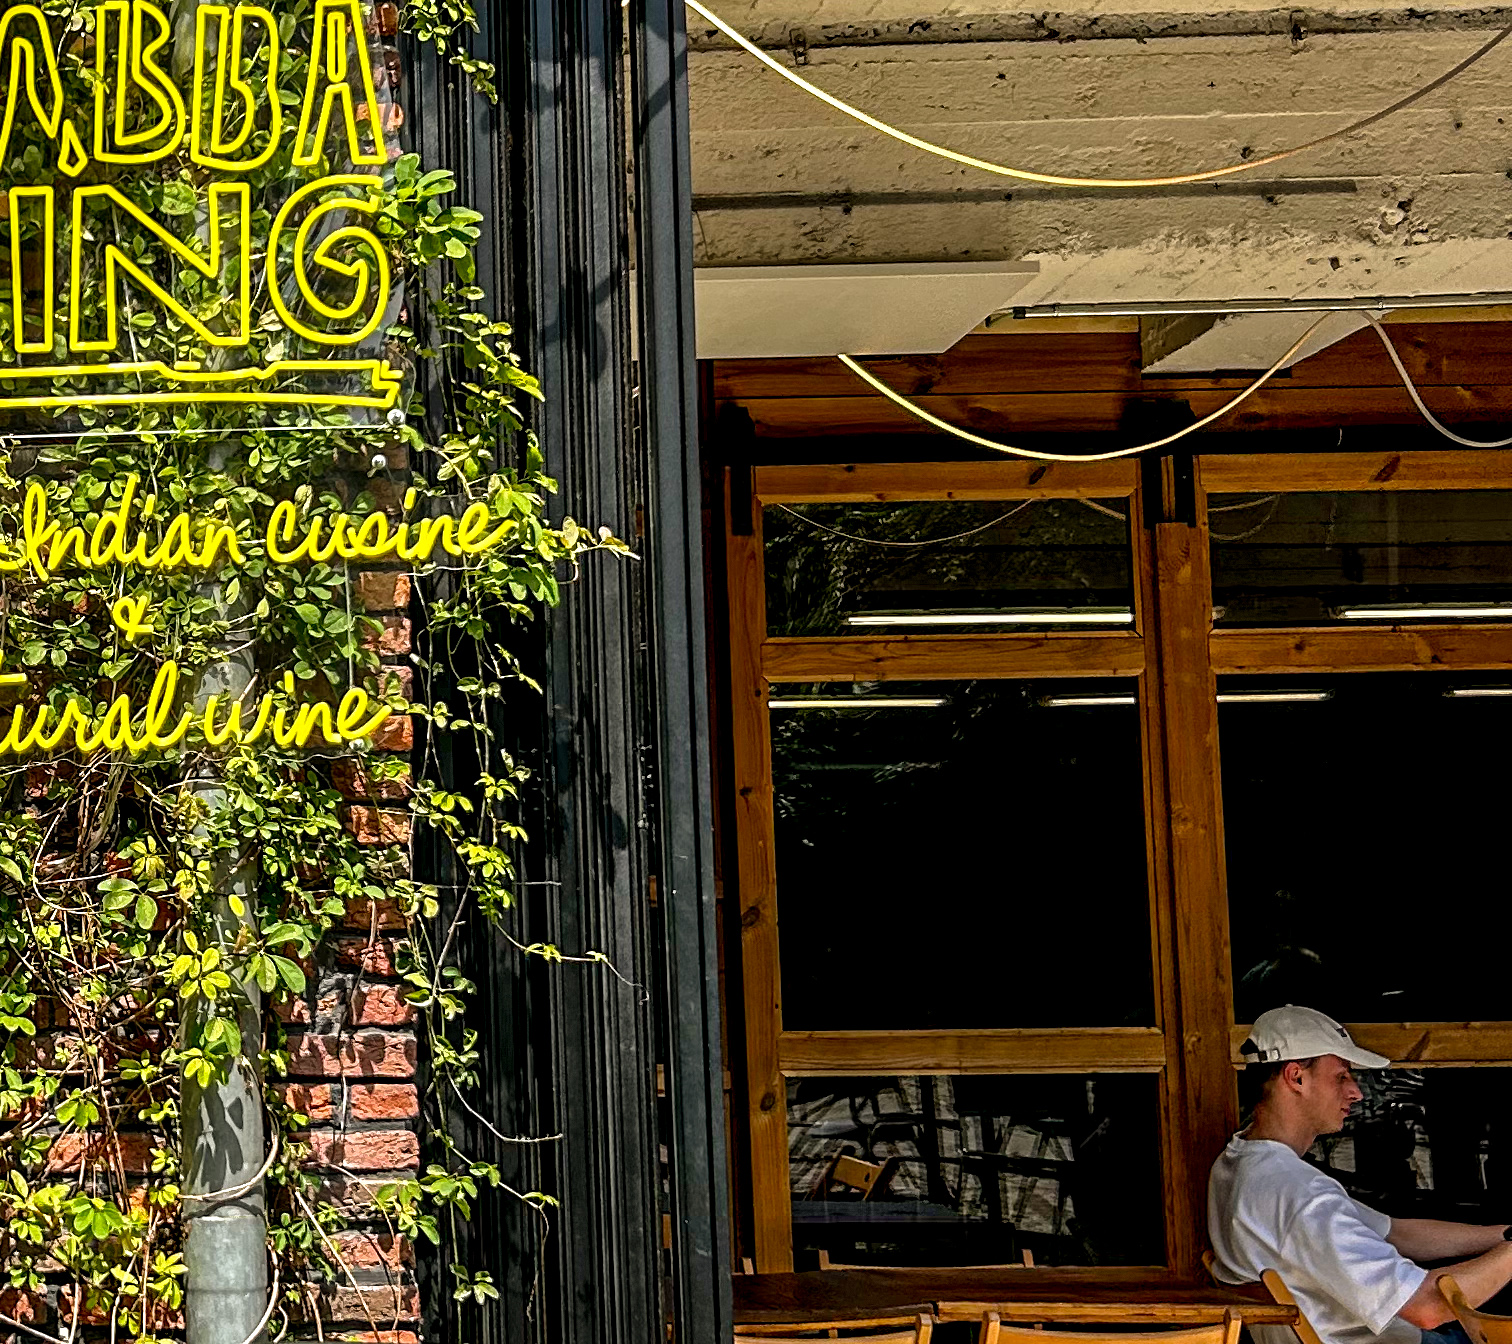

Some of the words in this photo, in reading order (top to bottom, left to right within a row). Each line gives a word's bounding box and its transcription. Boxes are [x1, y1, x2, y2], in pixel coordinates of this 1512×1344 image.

[266, 486, 519, 564] cusine
[110, 595, 152, 640] &
[200, 669, 393, 748] wine
